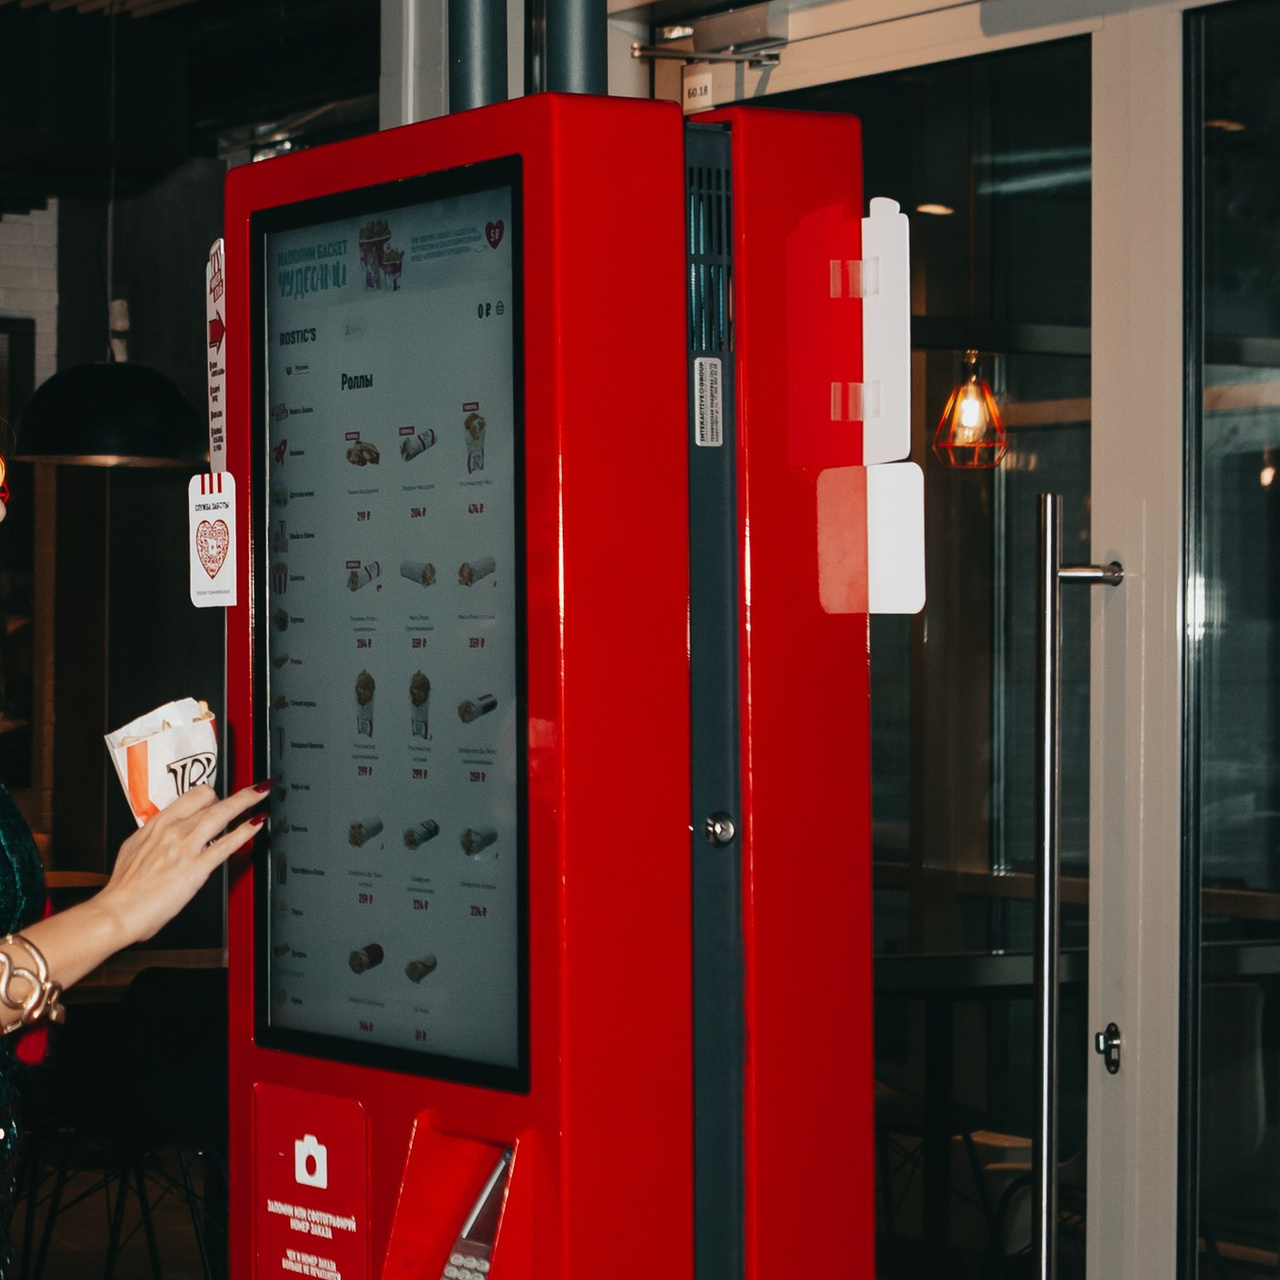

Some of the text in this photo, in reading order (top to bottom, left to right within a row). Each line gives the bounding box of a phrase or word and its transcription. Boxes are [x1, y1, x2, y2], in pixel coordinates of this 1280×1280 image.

[317, 239, 349, 260] БАСКЕТ
[279, 328, 317, 346] ROSTIC'S
[341, 373, 373, 390] Роллы
